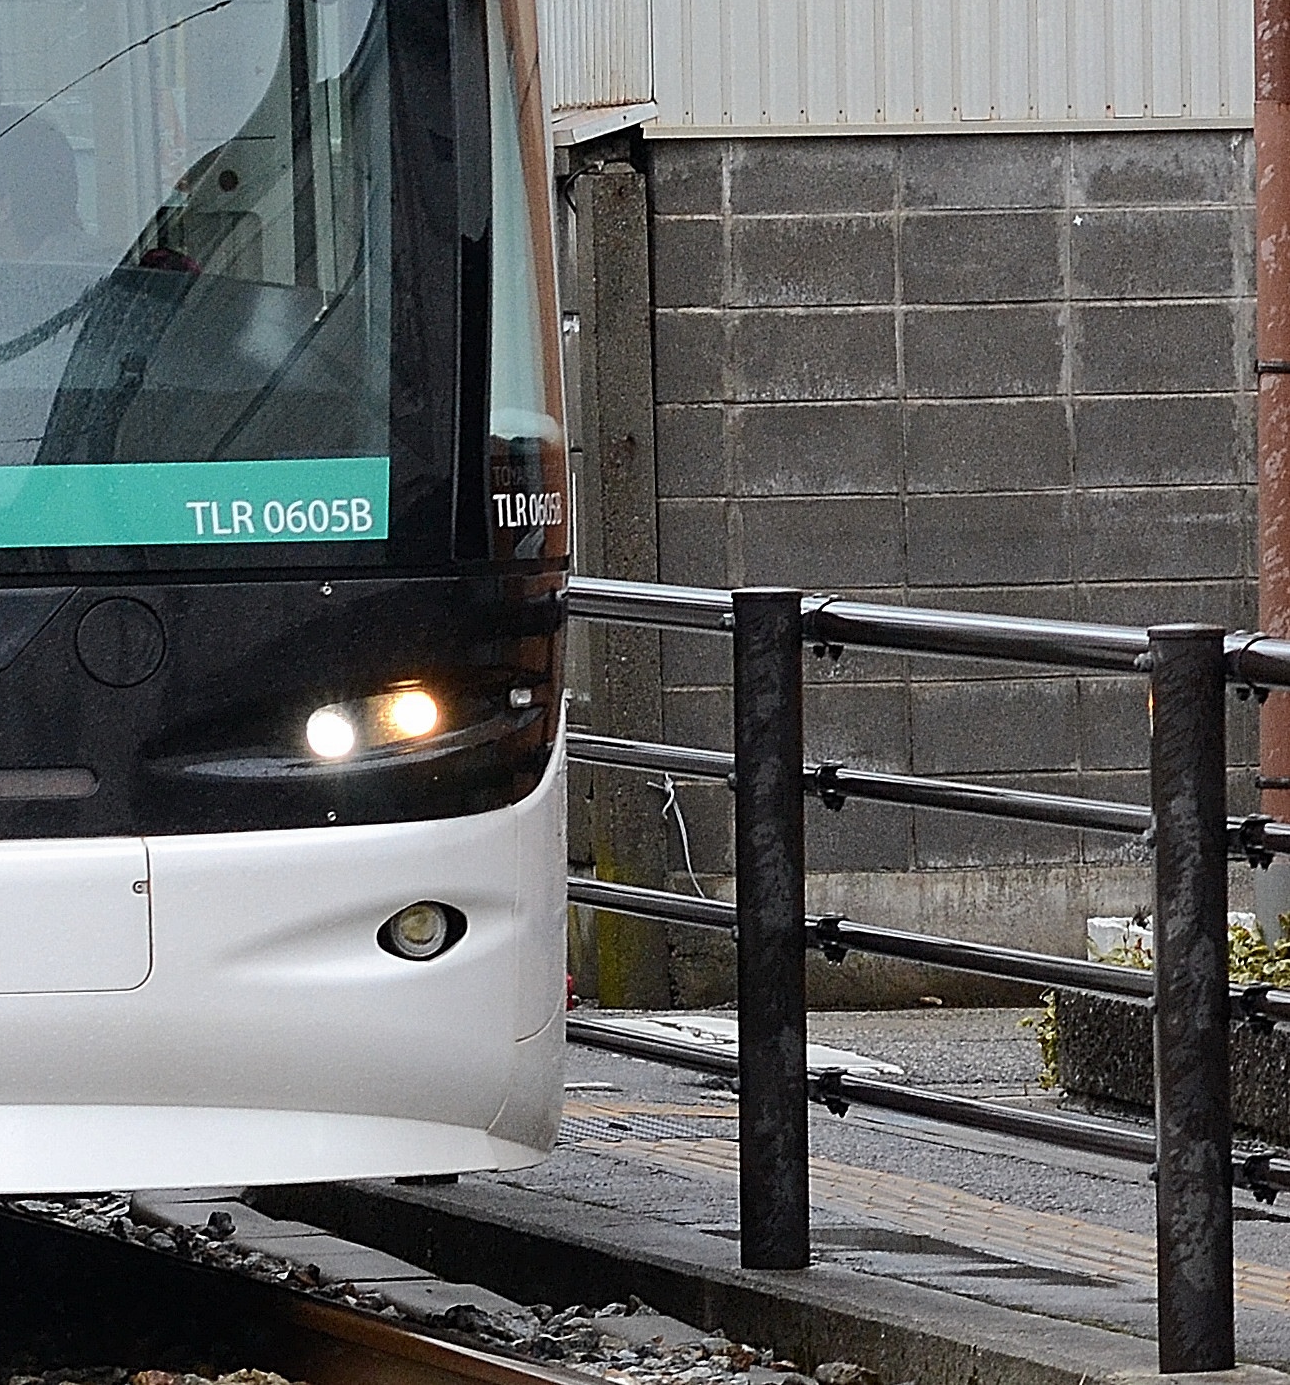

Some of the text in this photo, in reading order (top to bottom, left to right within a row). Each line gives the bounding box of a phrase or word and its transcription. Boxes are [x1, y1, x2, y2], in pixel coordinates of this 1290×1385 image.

[185, 497, 373, 536] TLR 0605B
[492, 492, 528, 528] TLR
